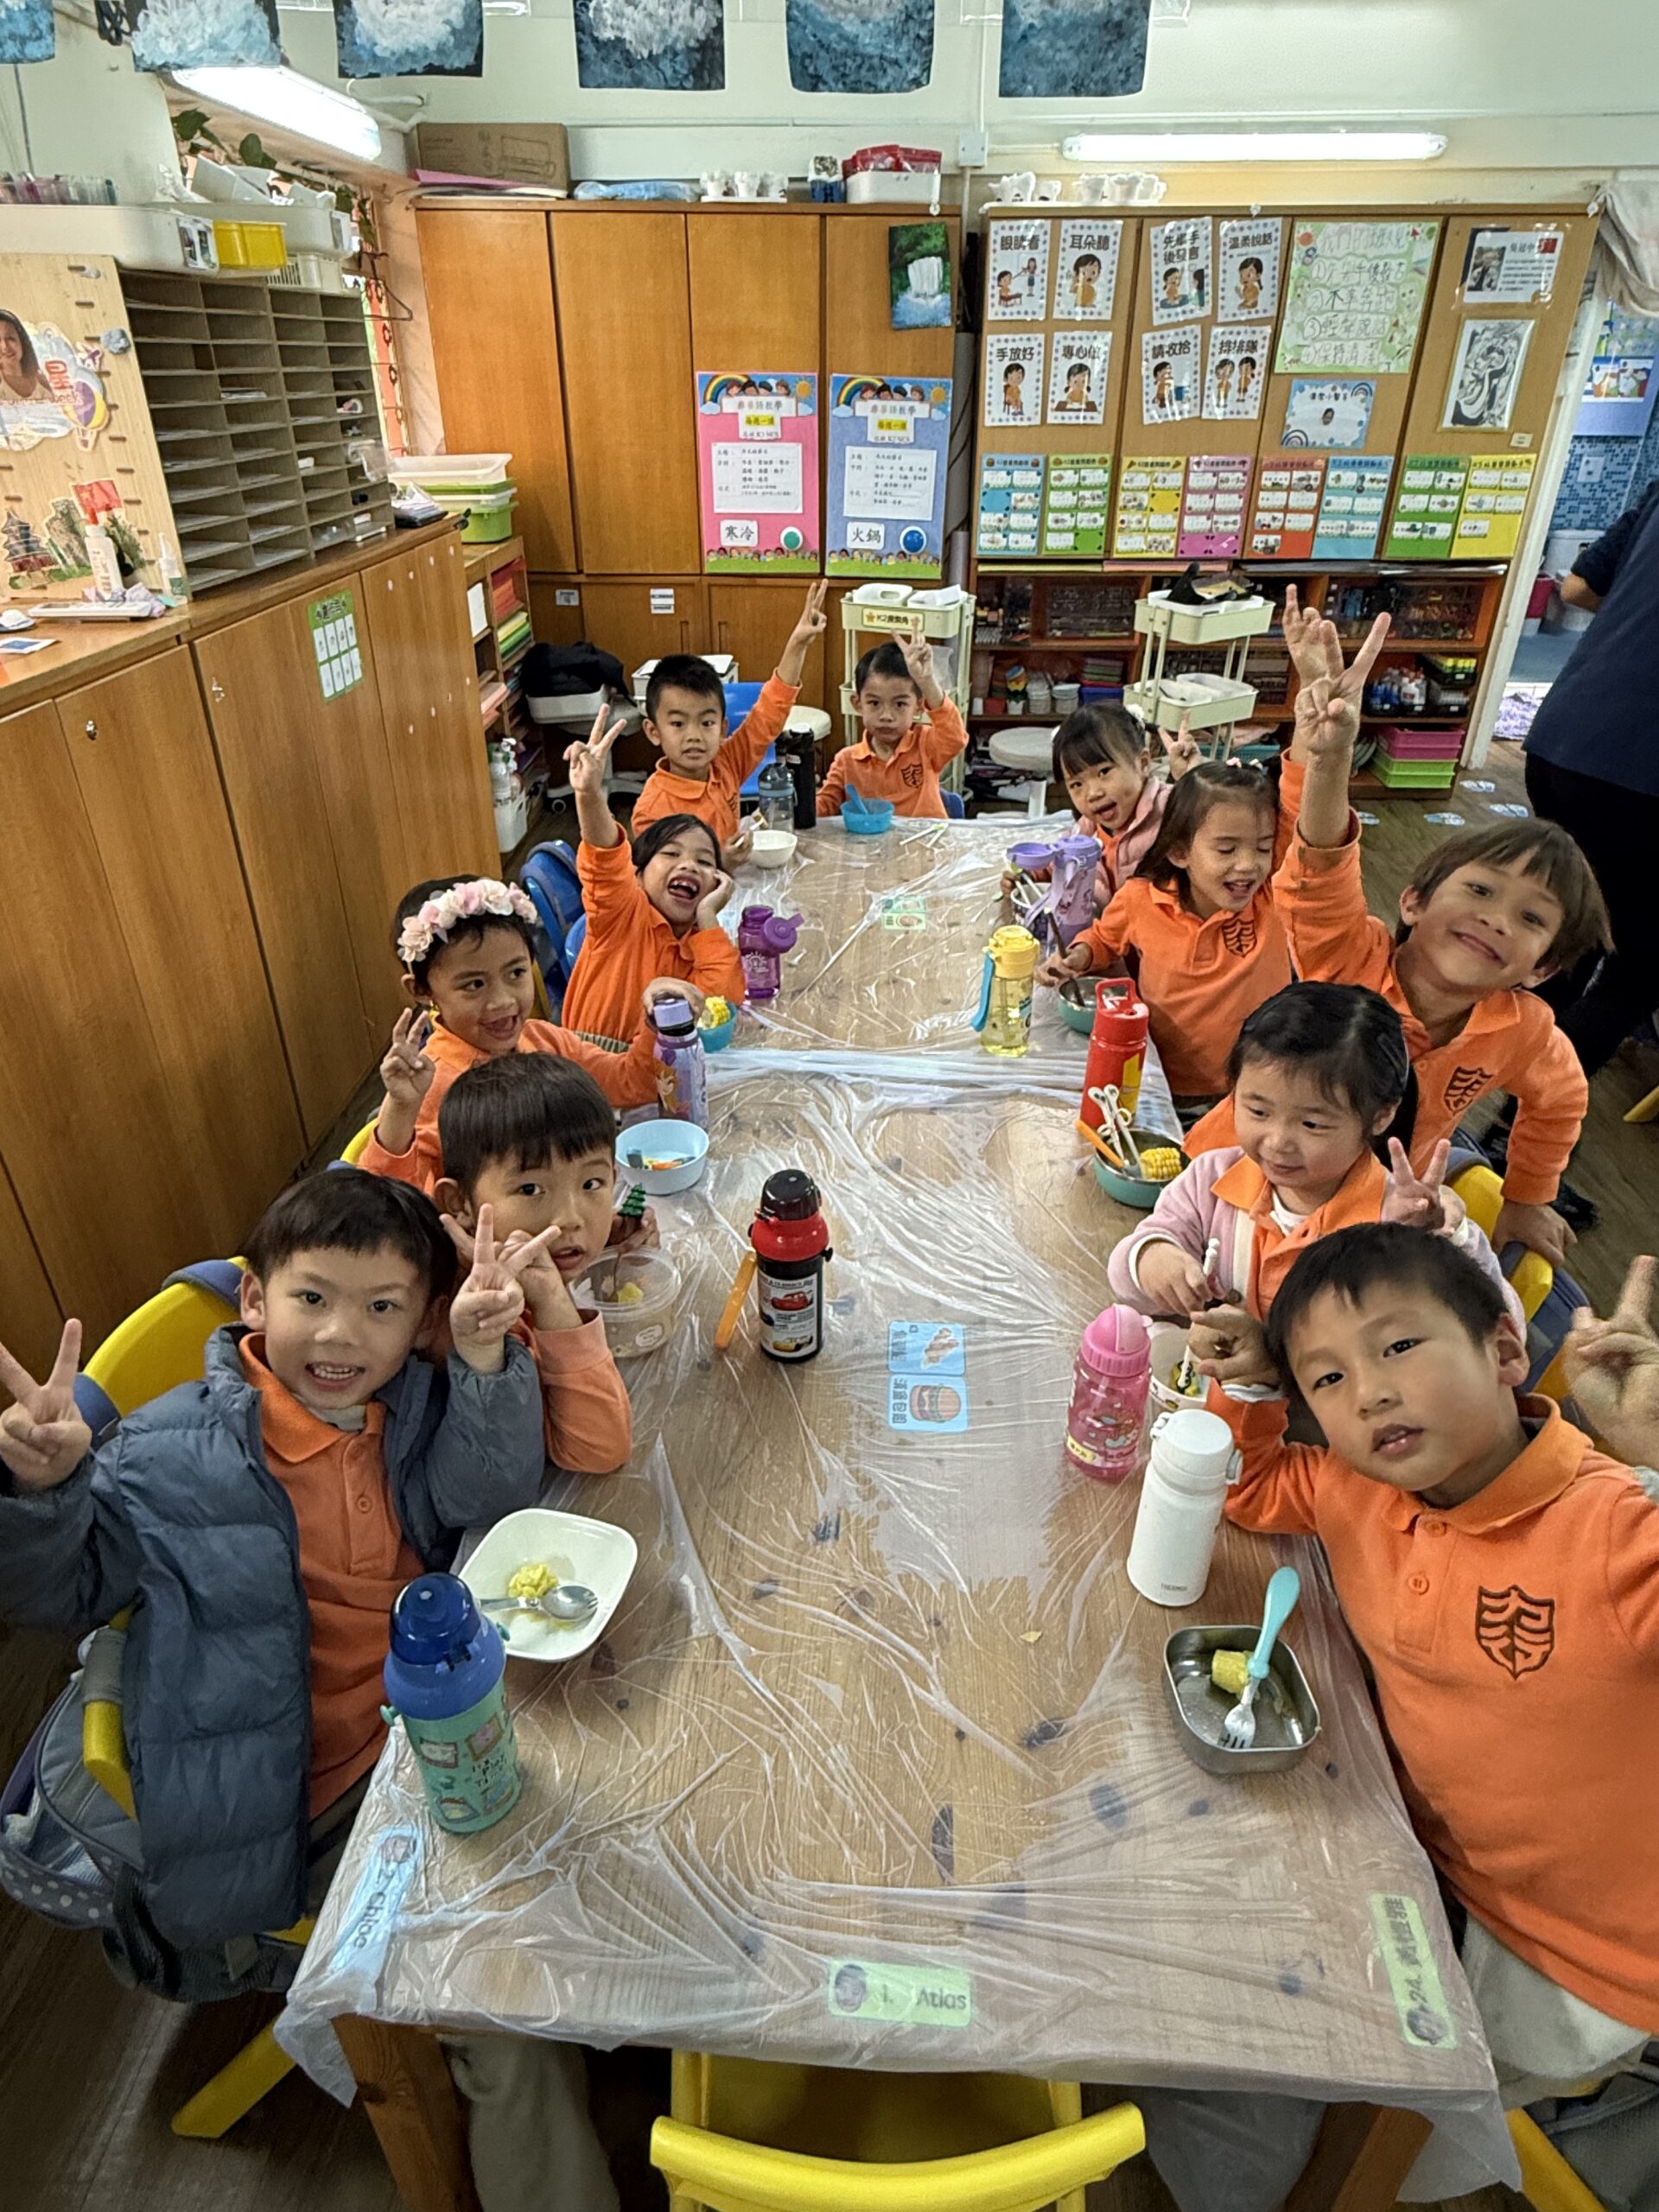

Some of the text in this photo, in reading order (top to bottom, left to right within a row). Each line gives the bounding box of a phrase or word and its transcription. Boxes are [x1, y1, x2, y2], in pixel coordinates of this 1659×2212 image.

[1000, 234, 1040, 251] 眼睛看
[1070, 234, 1109, 251] 耳朵聽
[1163, 230, 1200, 251] 先舉手
[1228, 232, 1273, 251] 溫柔說話
[1163, 245, 1200, 265] 後發言
[995, 346, 1034, 362] 手放好
[1062, 345, 1101, 360] 專心做
[1153, 340, 1192, 359] 請收拾
[1218, 340, 1258, 356] 排排隊
[724, 524, 755, 541] 寒冷
[852, 528, 882, 544] 火鍋
[916, 1987, 967, 2011] Atlas
